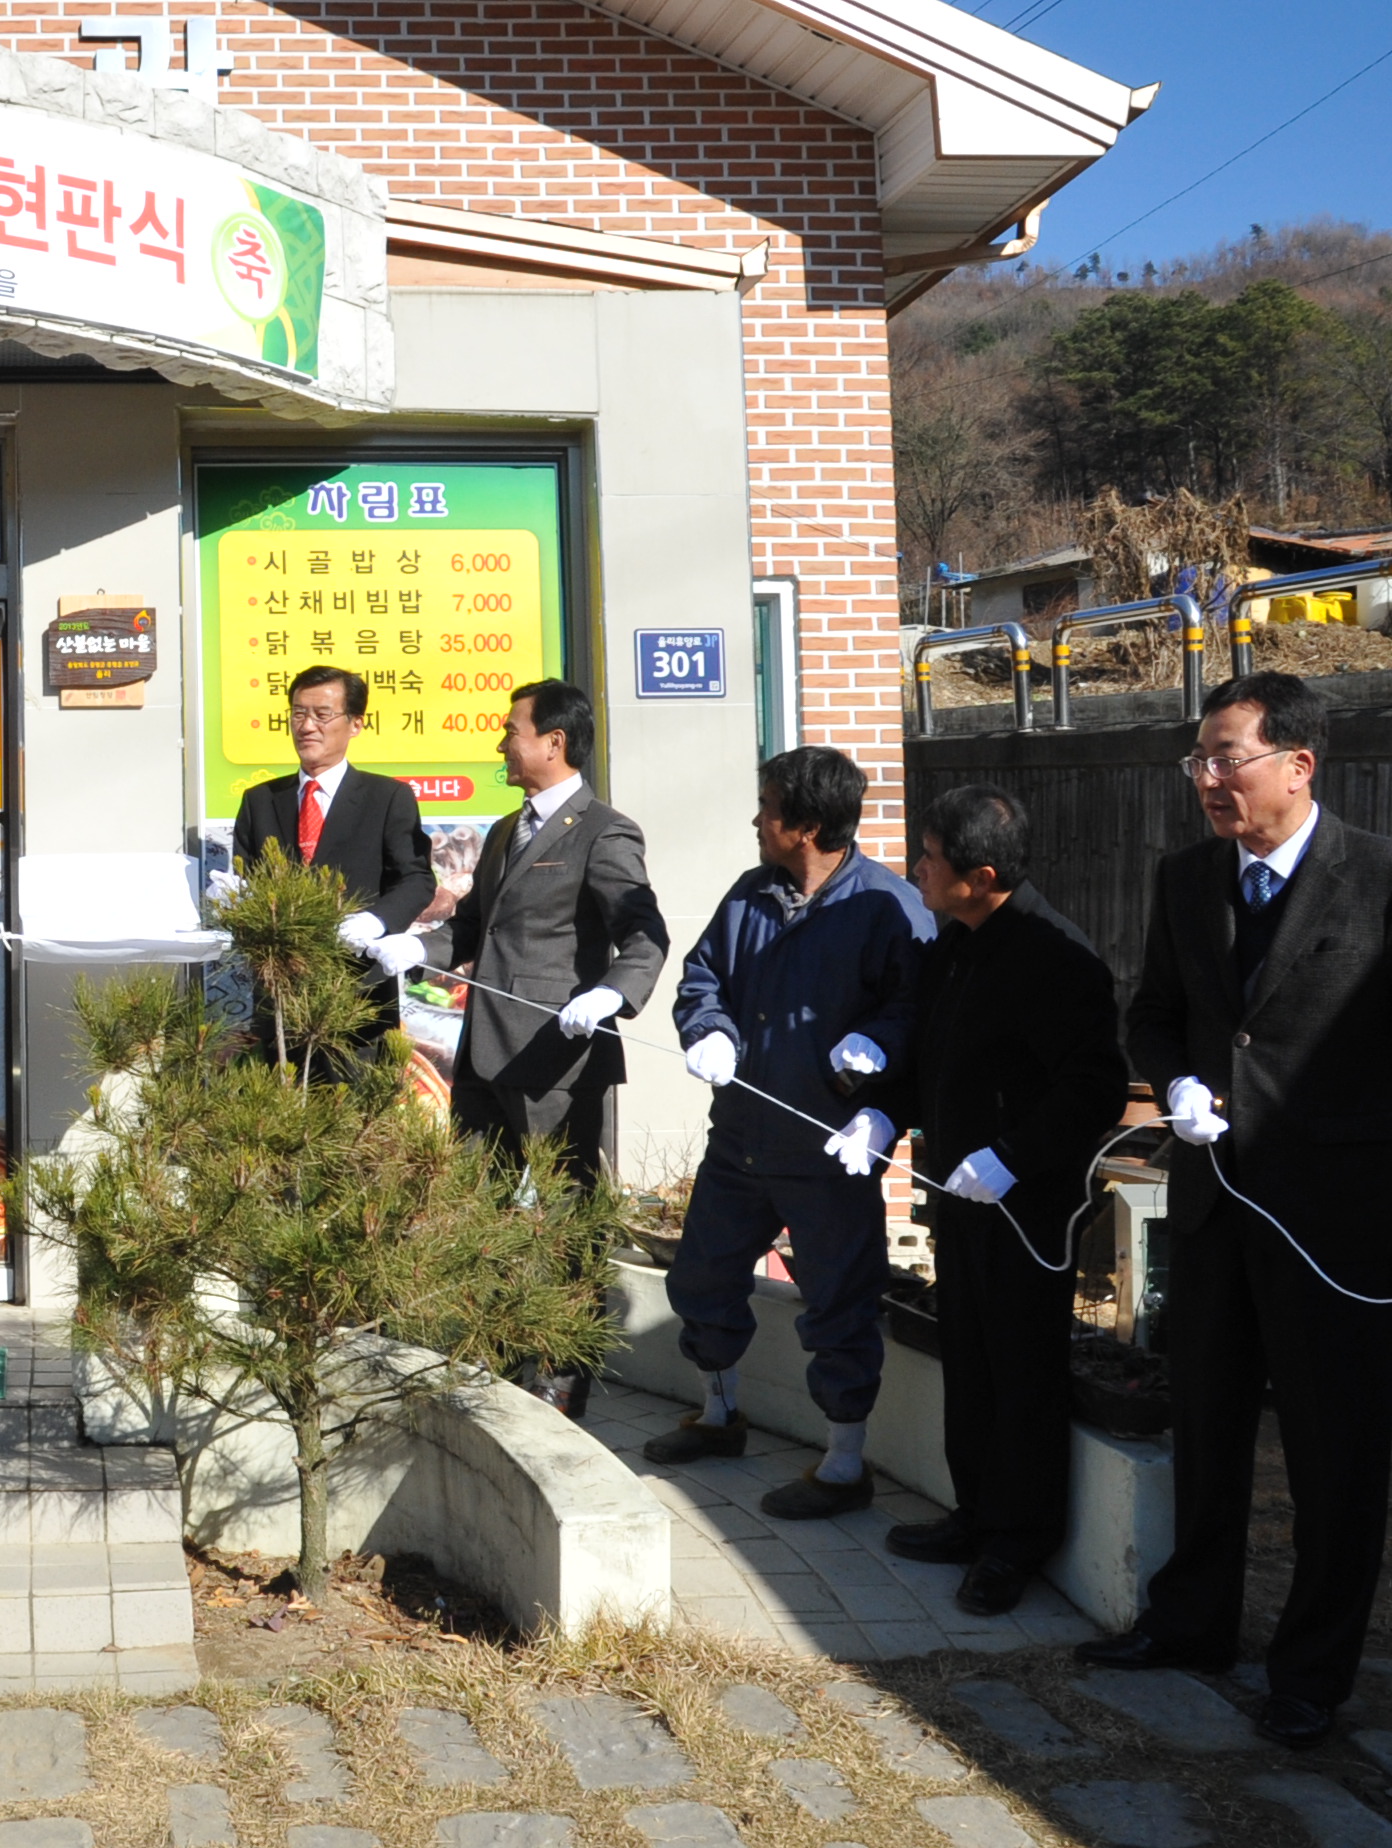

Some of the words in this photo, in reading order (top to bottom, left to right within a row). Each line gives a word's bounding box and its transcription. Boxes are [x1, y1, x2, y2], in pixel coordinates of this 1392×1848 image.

[228, 226, 272, 300] 축
[309, 483, 446, 520] 차림표
[450, 553, 511, 576] 6,000
[264, 589, 423, 616] 산채비빔밥
[453, 594, 513, 617] 7,000
[56, 634, 117, 654] 산불없는
[119, 633, 151, 653] 마을
[440, 633, 513, 656] 35,000
[652, 650, 706, 678] 301
[441, 672, 514, 695] 40,000
